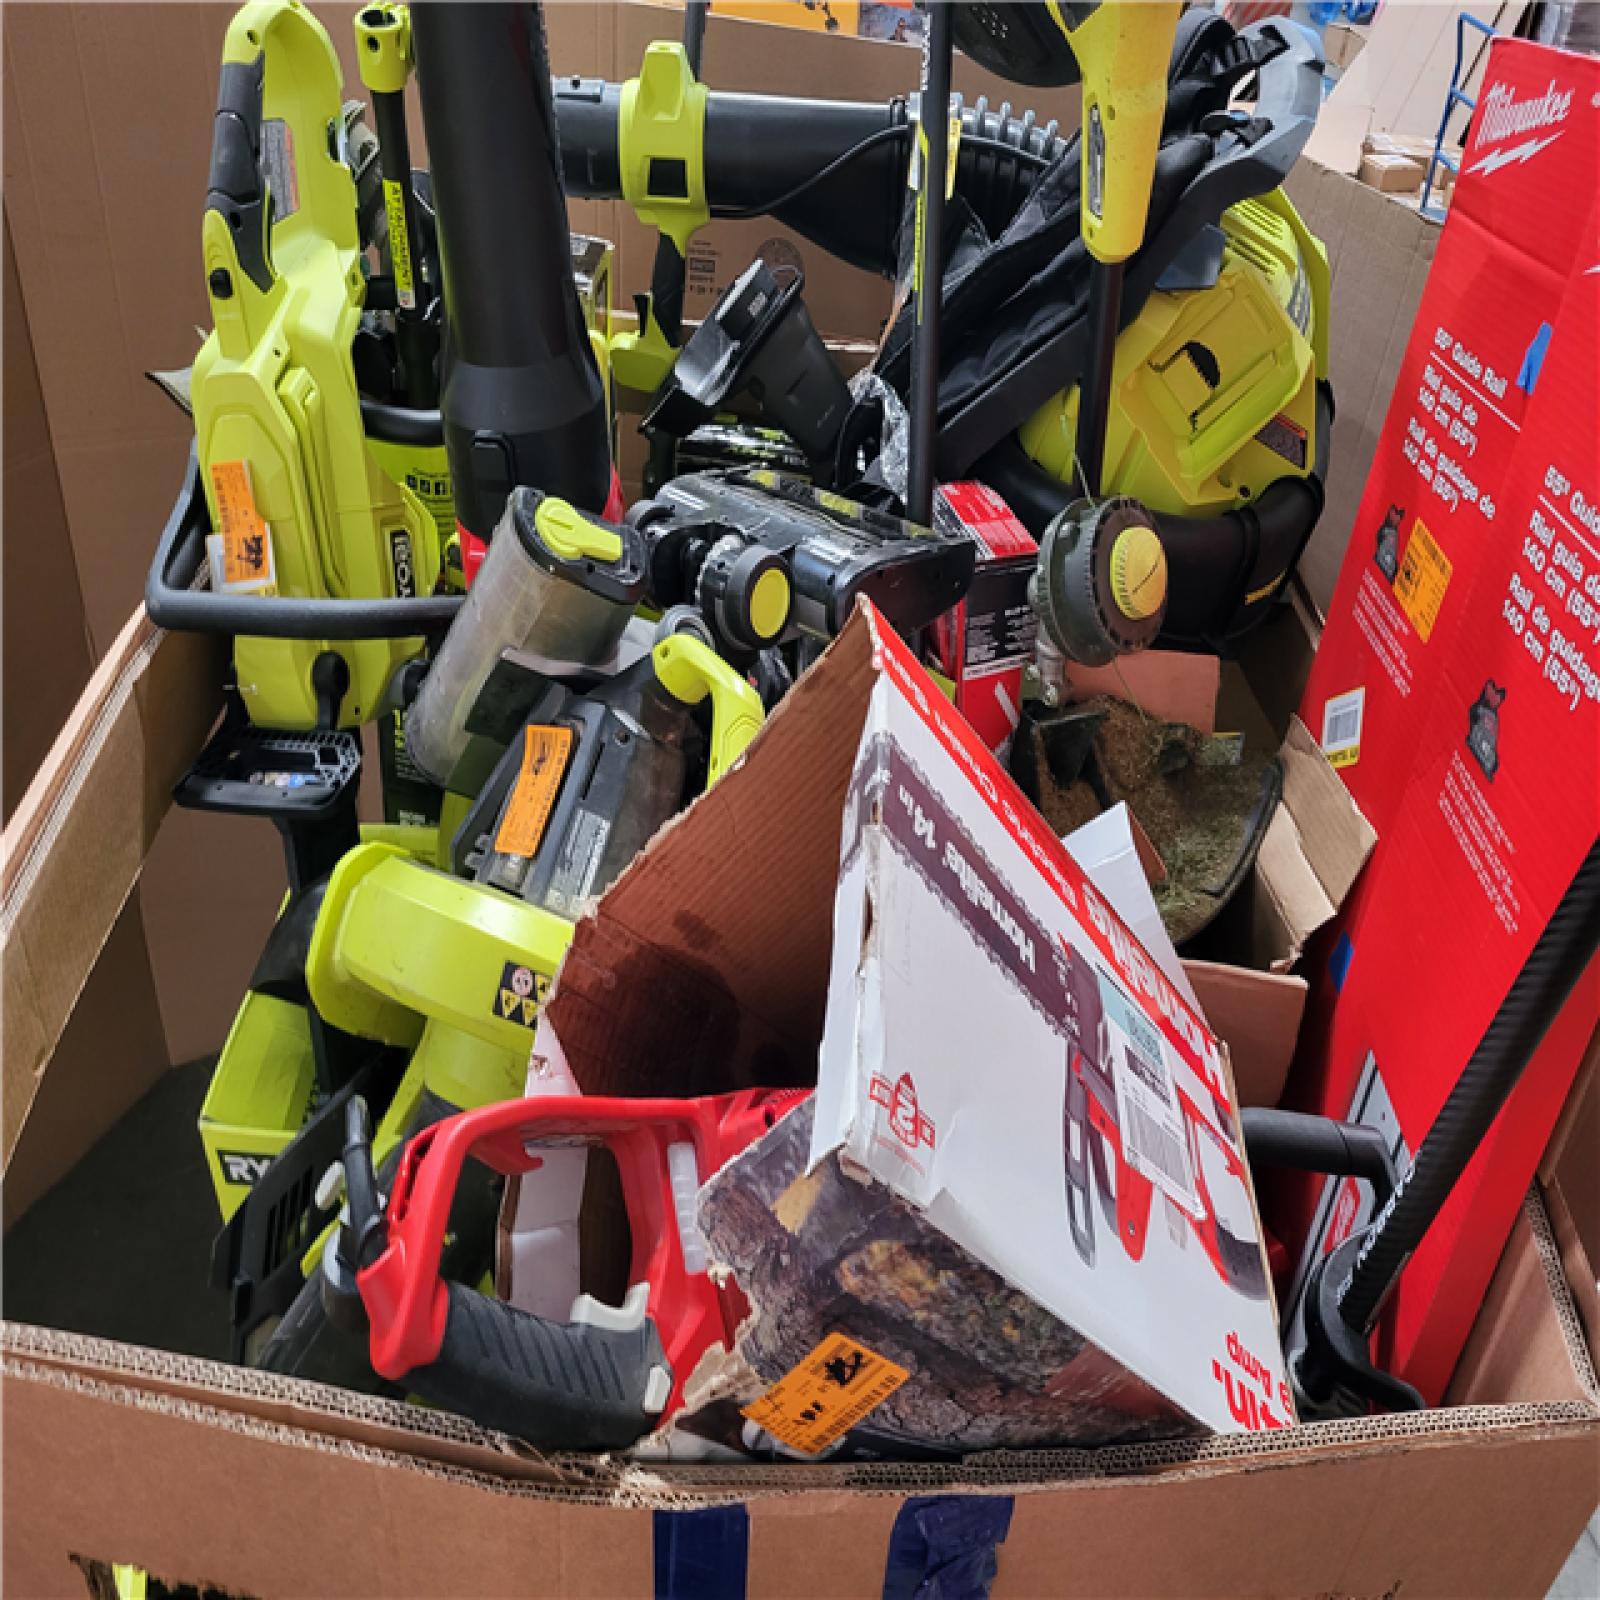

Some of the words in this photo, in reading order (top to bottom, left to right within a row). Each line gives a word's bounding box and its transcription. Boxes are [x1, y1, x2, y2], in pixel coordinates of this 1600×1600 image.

[1475, 78, 1575, 152] Milwaukee
[1452, 341, 1482, 379] Guide
[1482, 366, 1508, 399] Rail
[1434, 404, 1450, 428] cm
[1462, 403, 1478, 426] de
[1408, 415, 1427, 446] Rail
[1424, 437, 1438, 460] de
[1437, 451, 1478, 503] guidage
[1480, 494, 1496, 519] de
[1418, 458, 1433, 483] cm
[1529, 508, 1556, 549] Riel
[1570, 488, 1600, 536] Guid
[1522, 536, 1545, 573] 140
[1545, 566, 1566, 598] cm
[1502, 598, 1525, 635] 140
[1524, 629, 1545, 663] cm
[1509, 571, 1534, 612] Rail
[1532, 605, 1550, 634] de
[1549, 628, 1600, 703] guidag
[912, 804, 937, 849] 14
